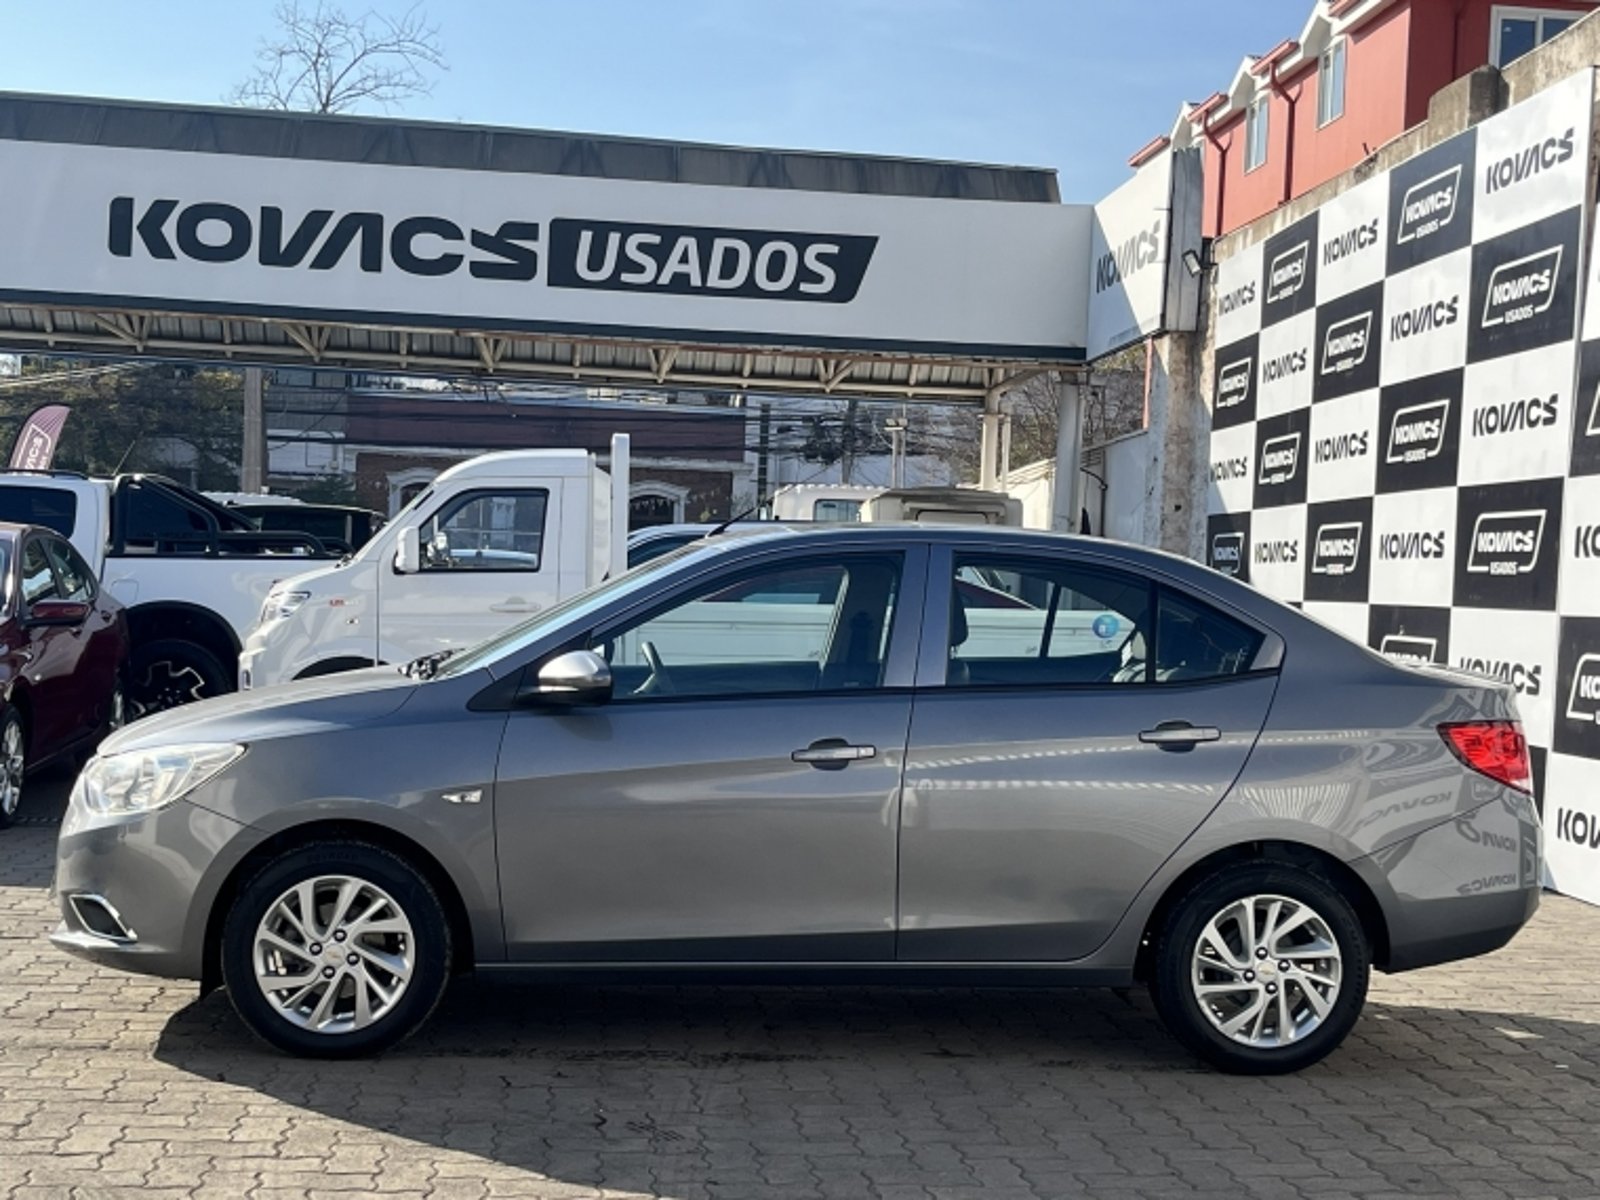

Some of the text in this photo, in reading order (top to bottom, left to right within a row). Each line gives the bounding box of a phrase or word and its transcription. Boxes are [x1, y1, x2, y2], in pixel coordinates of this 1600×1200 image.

[1486, 127, 1574, 194] KOVACS
[1405, 186, 1453, 224] KOVACS
[108, 196, 841, 295] KOVACS USADOS
[1096, 219, 1161, 294] KOVACS
[1323, 218, 1379, 266] KOVACS
[1492, 269, 1551, 306] KOVACS
[1390, 295, 1459, 342] KOVACS
[1263, 347, 1308, 384] KOVACS
[1395, 418, 1441, 446] KOVACS
[1472, 394, 1559, 437] KOVACS
[1315, 430, 1369, 464] KOVACS
[1254, 540, 1298, 565] KOVACS
[1319, 538, 1355, 557] KOVACS
[1379, 531, 1445, 560] KOVACS
[1477, 530, 1535, 552] KOVACS
